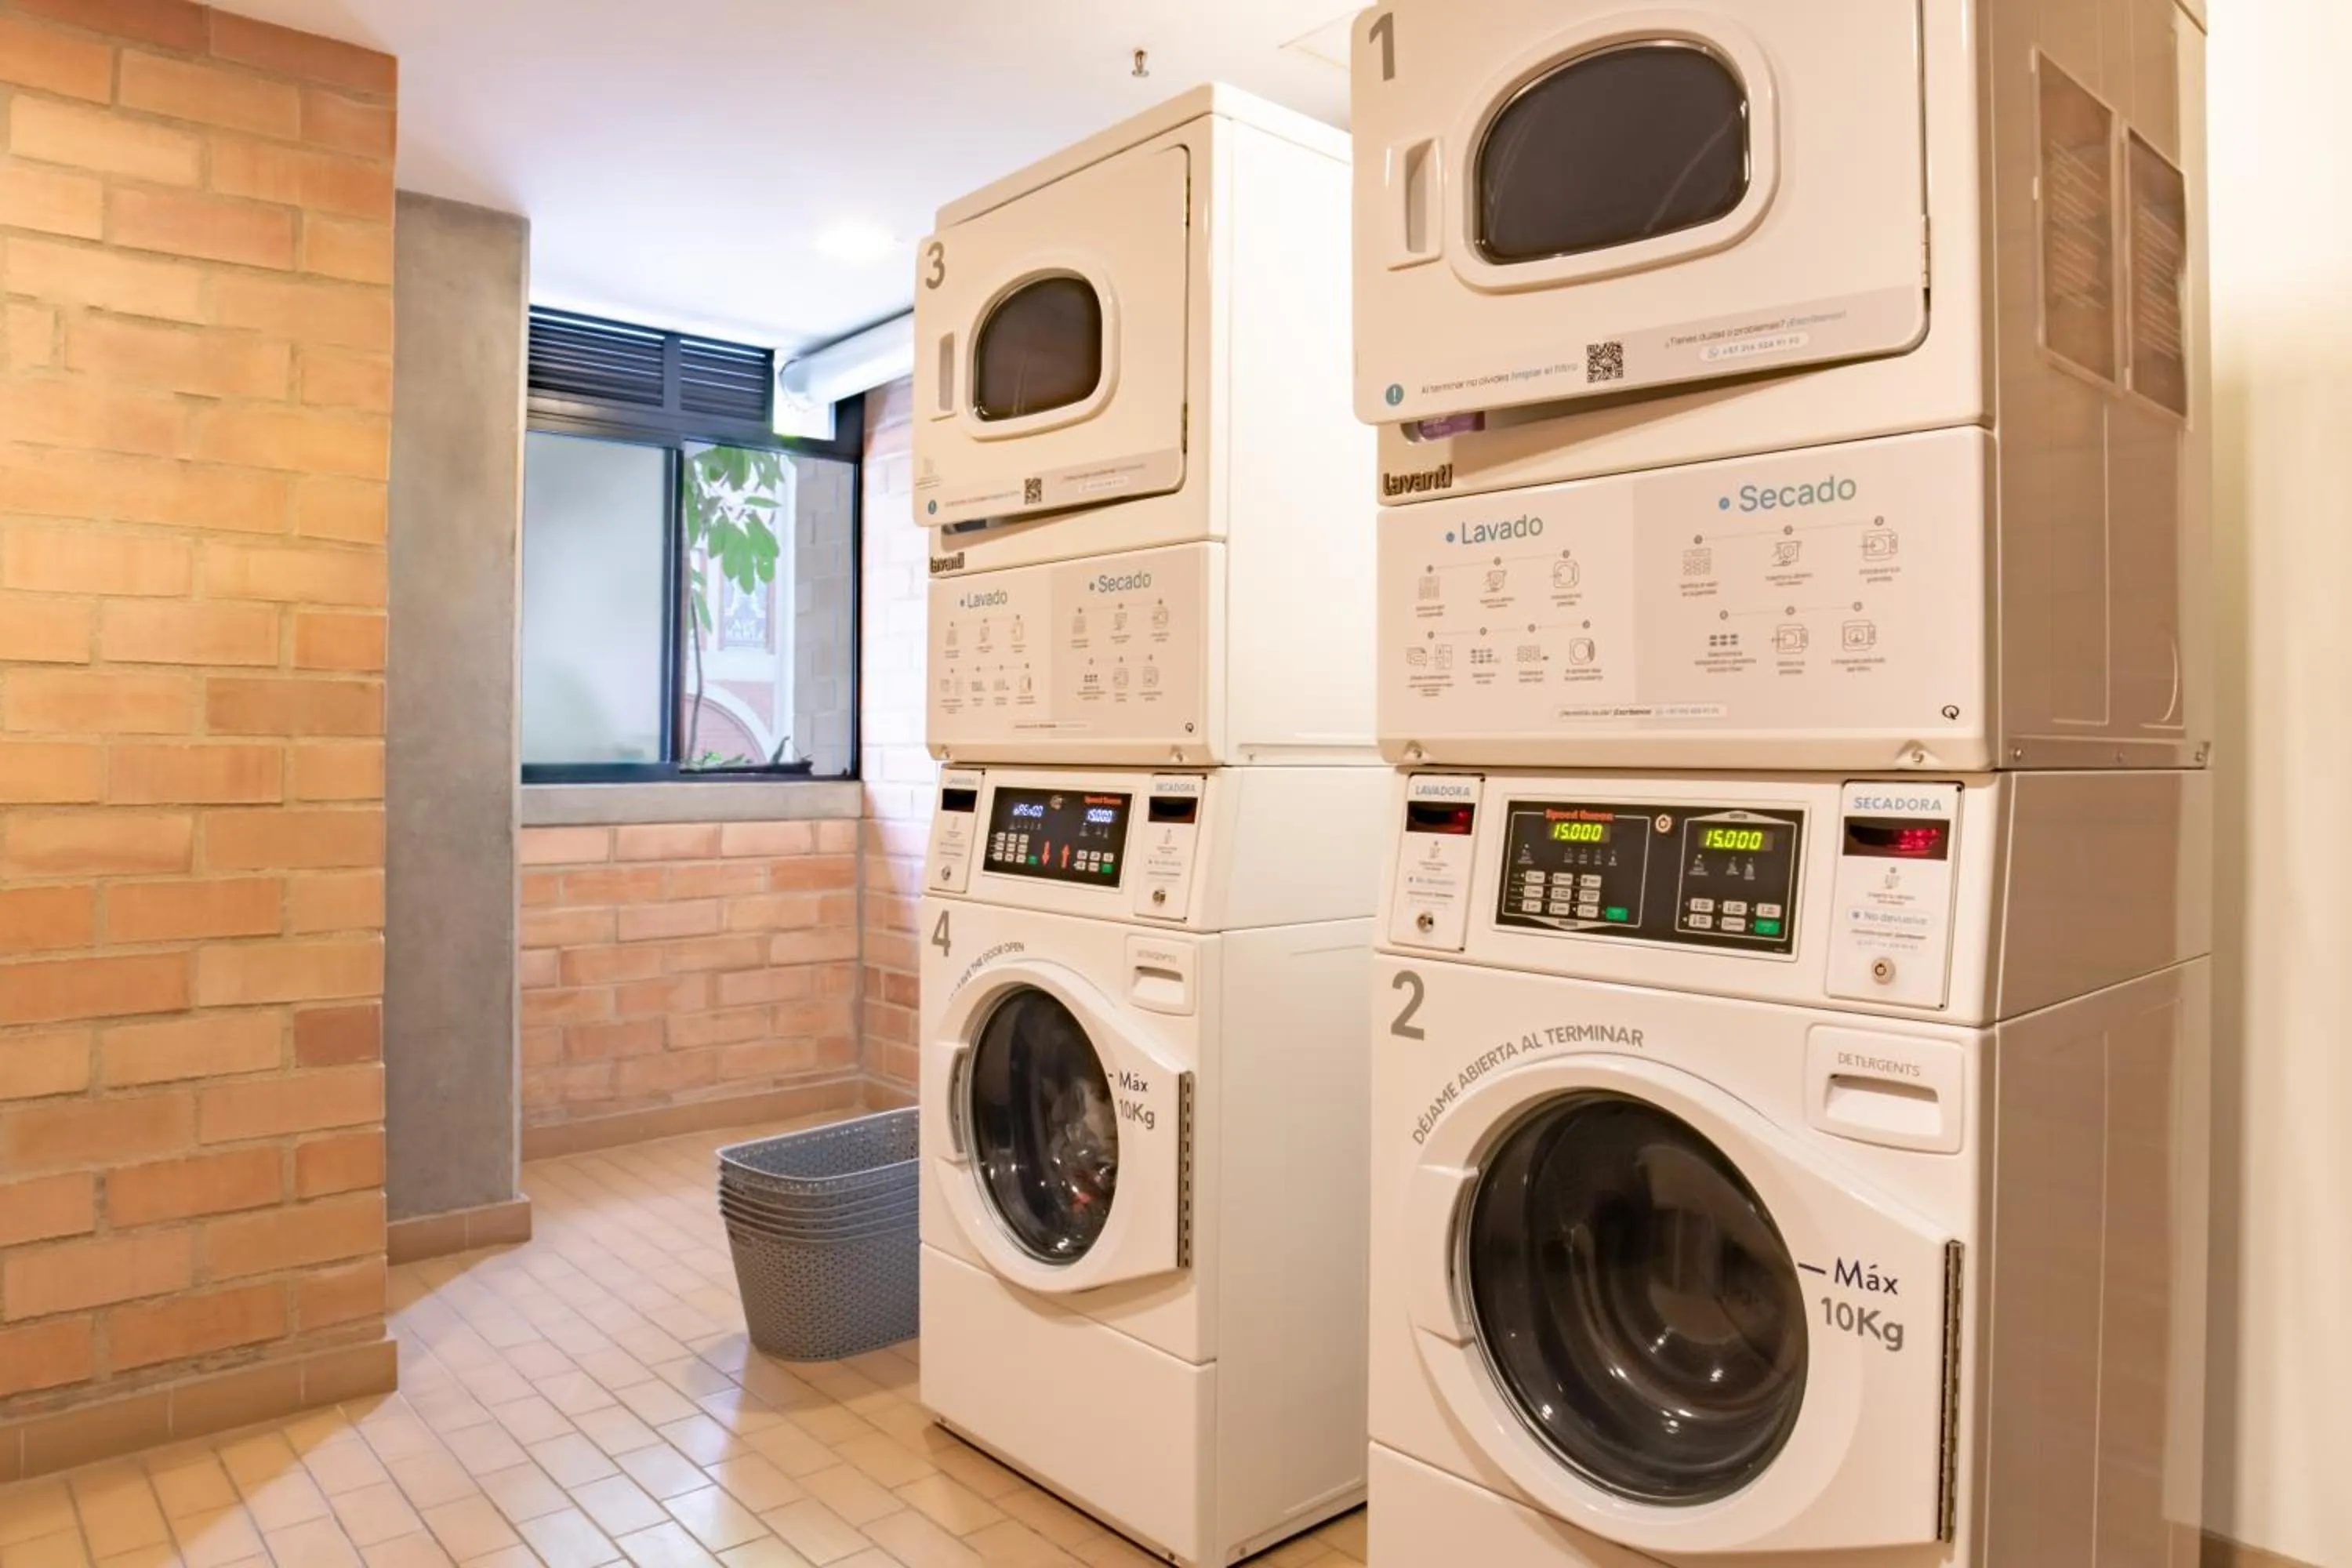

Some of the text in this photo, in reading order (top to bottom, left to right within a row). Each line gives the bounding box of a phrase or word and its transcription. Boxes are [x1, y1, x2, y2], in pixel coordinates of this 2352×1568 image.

[1369, 12, 1396, 82] 1
[926, 241, 946, 290] 3
[1739, 475, 1857, 512] Secado
[1461, 514, 1544, 544] Lavado
[967, 589, 1008, 608] Lavado
[1098, 571, 1152, 593] Secado
[1414, 785, 1471, 797] LAVADORA
[1853, 797, 1942, 811] SECADORA
[931, 909, 951, 957] 4
[1391, 970, 1425, 1041] 2
[1838, 1051, 1921, 1077] DETERGENTS
[1412, 1024, 1644, 1145] DÉJAME ABIERTA AL TERMINAR
[1119, 1098, 1155, 1130] 10Kg
[1835, 1256, 1899, 1295] Máx
[1820, 1297, 1904, 1352] 10Kg
